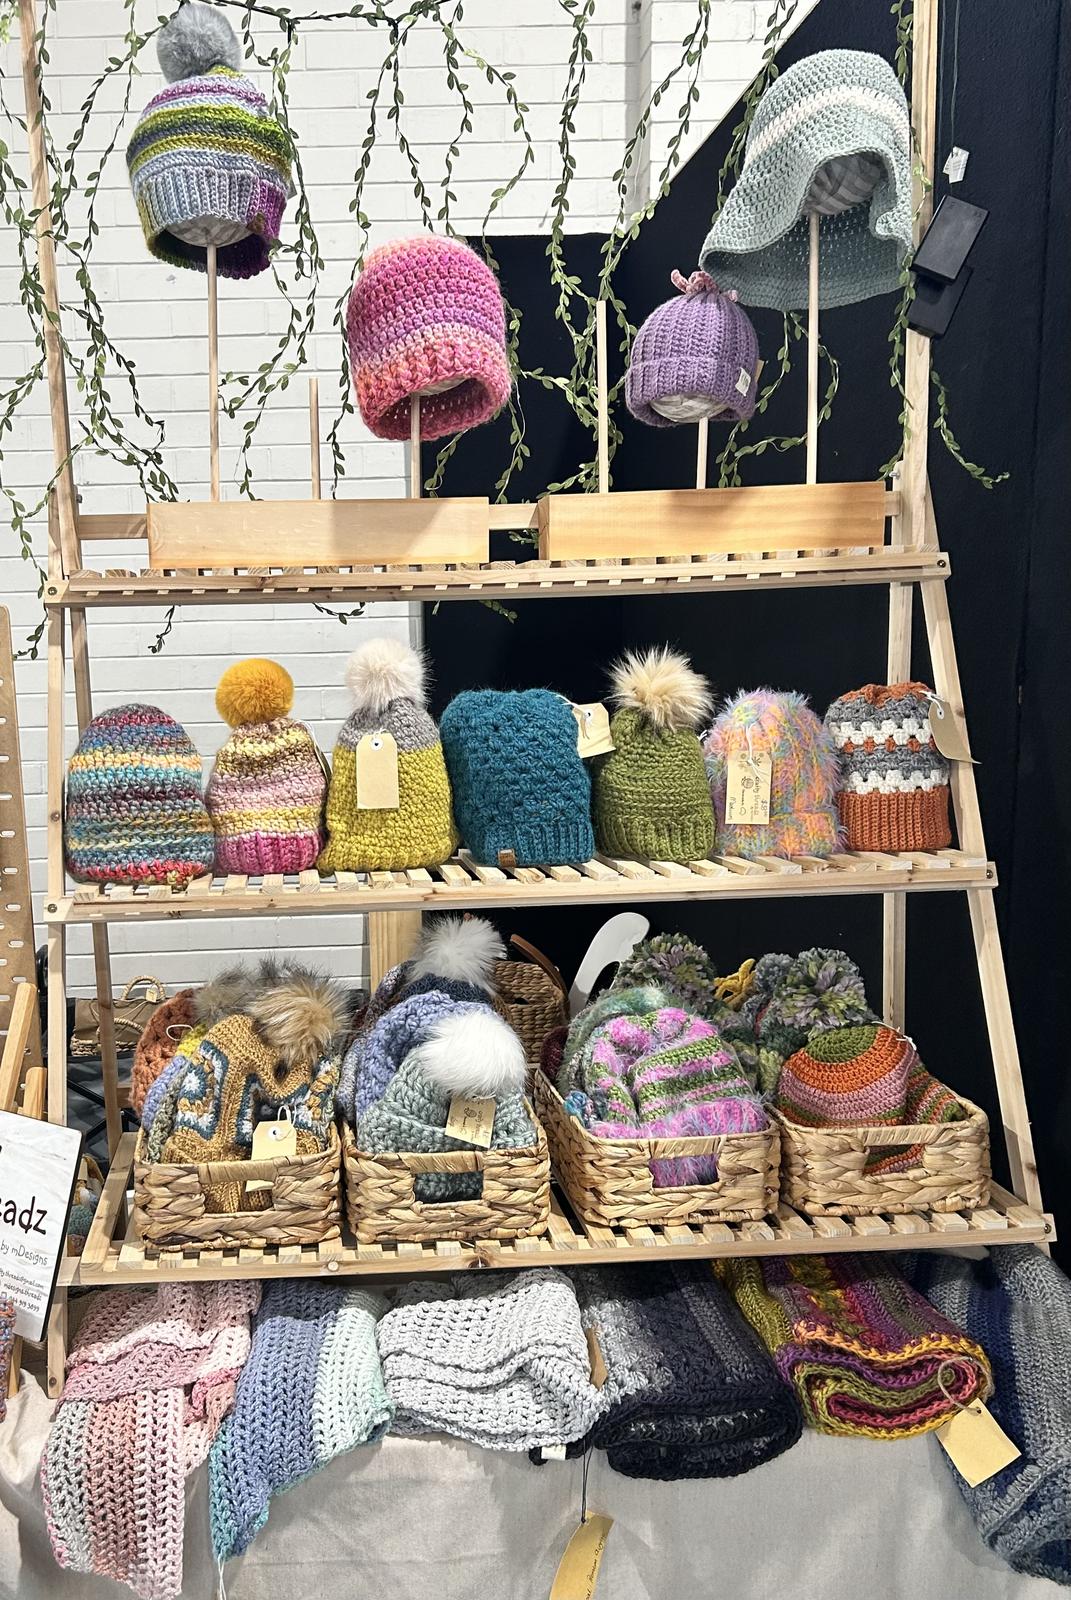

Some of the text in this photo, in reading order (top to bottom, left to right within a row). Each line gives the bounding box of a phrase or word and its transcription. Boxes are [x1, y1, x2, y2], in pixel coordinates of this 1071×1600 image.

[0, 1195, 48, 1236] adz
[1, 1240, 48, 1266] by mDesigns
